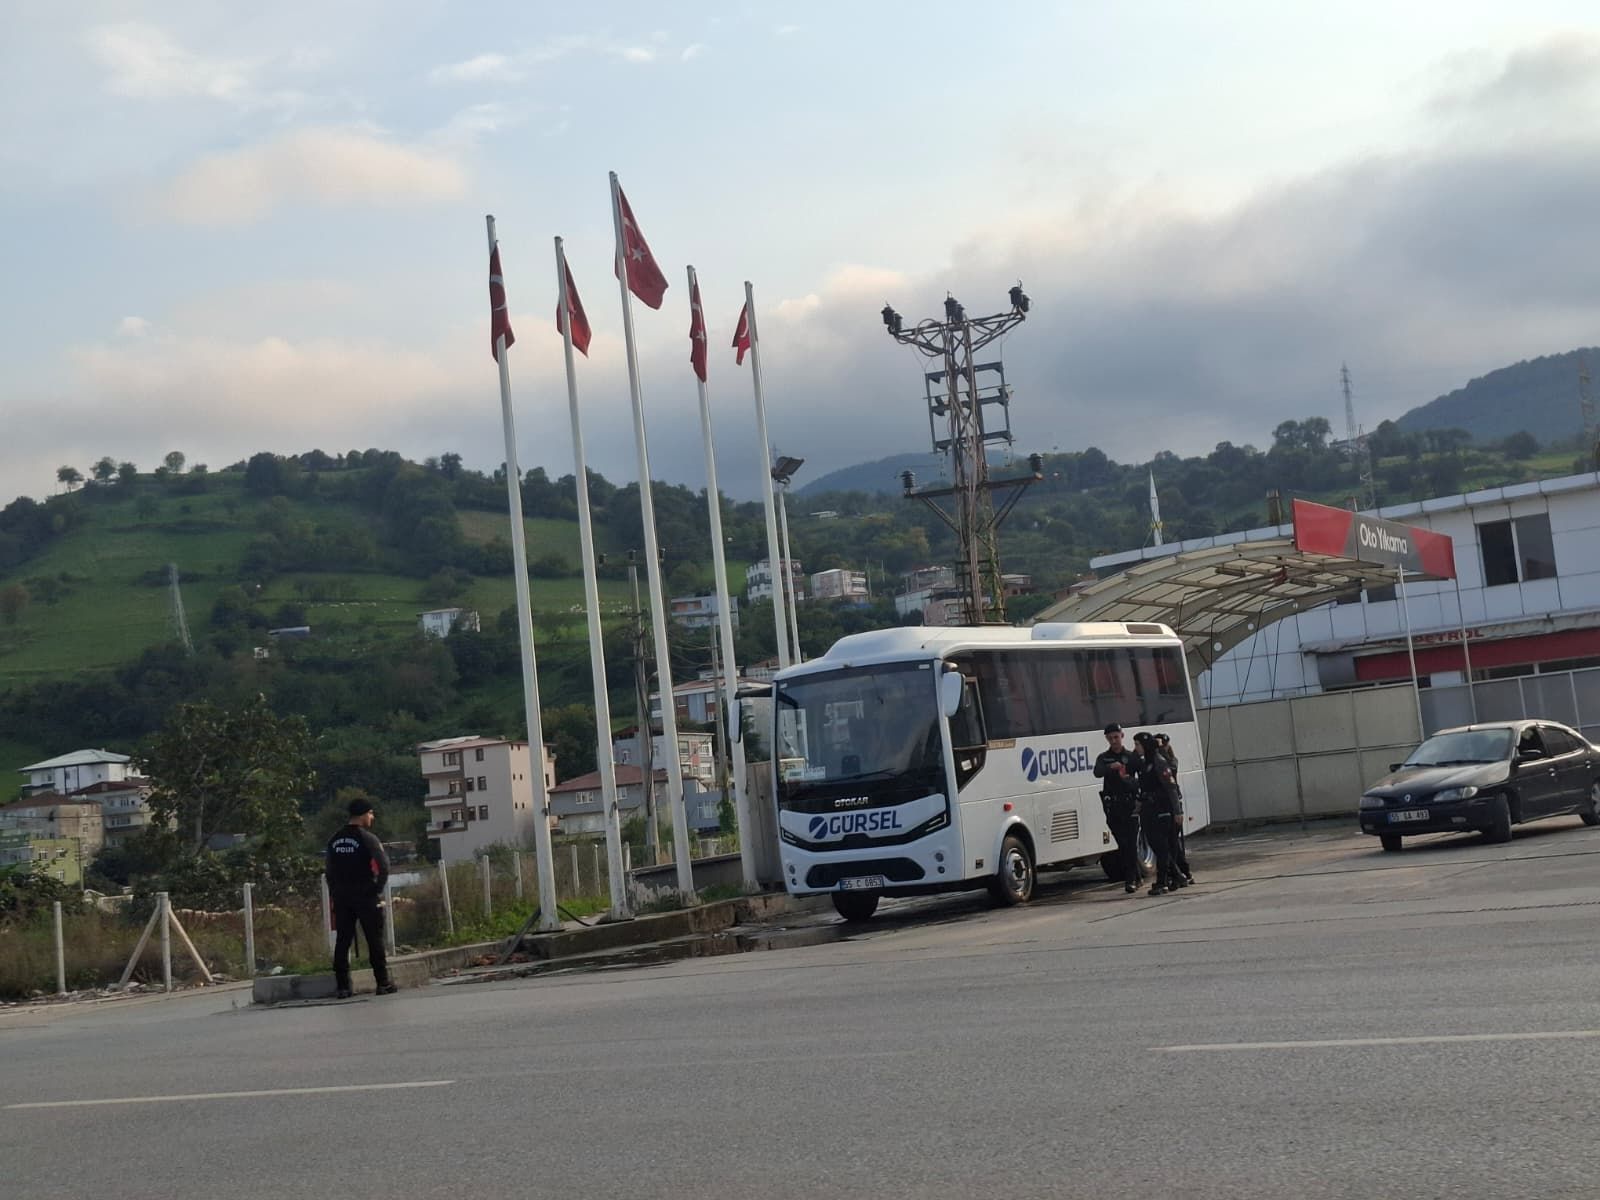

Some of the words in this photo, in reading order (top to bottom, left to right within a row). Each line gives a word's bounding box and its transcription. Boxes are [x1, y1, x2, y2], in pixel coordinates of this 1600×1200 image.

[1360, 523, 1377, 548] Oto
[1039, 746, 1093, 776] GÜRSEL
[834, 796, 869, 808] OTOKAR
[829, 810, 902, 835] GÜRSEL
